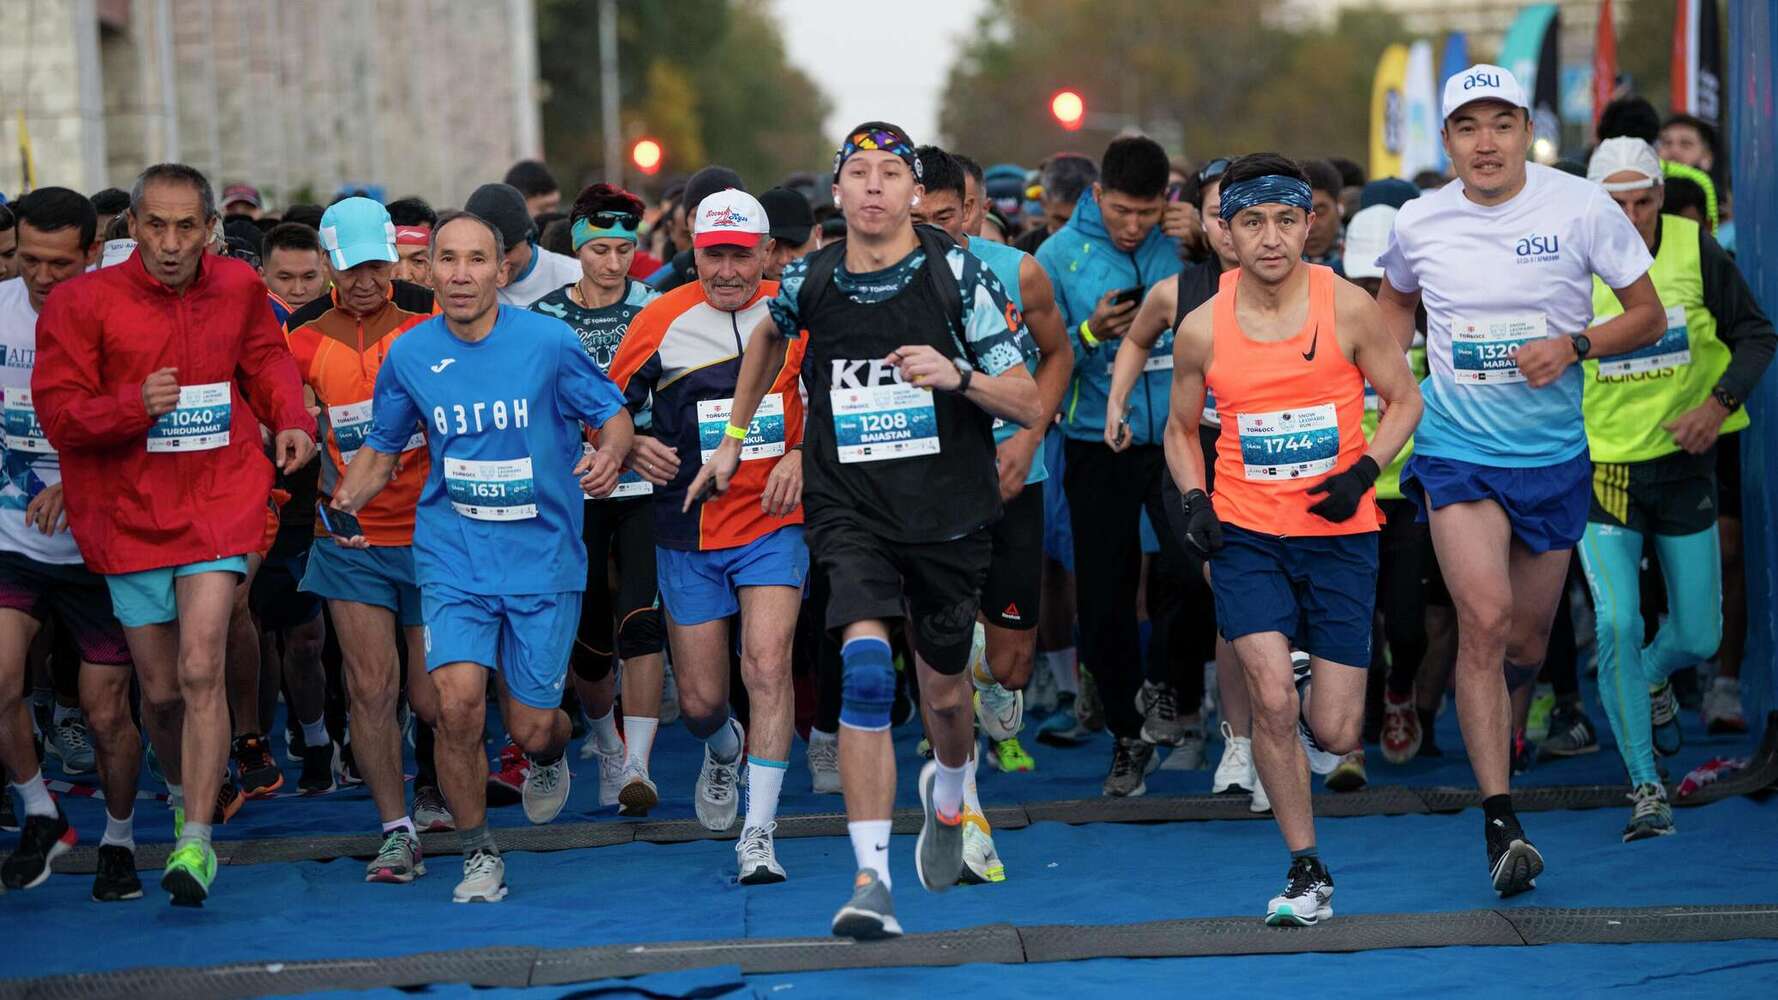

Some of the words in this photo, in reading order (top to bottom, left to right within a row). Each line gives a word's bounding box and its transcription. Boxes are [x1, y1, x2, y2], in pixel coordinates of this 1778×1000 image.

[170, 409, 213, 426] 1040
[859, 412, 907, 432] 1208
[161, 424, 221, 436] TURDUMAMAT
[860, 430, 911, 442] BAIASTAN
[1263, 434, 1313, 454] 1744
[470, 483, 506, 497] 1631
